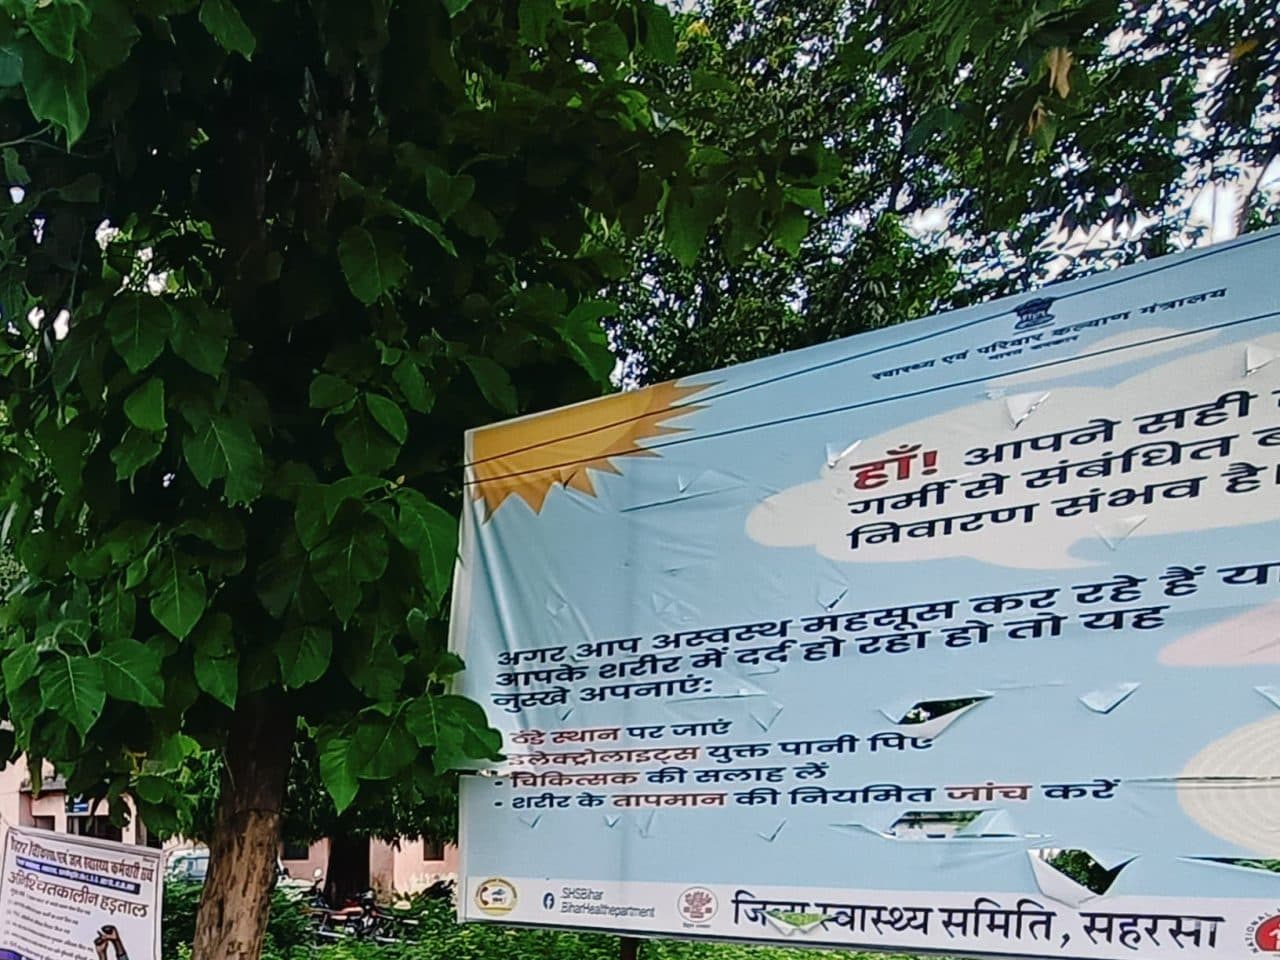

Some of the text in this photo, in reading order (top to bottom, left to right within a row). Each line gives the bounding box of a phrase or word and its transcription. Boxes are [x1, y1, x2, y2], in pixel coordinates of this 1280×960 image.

[942, 350, 969, 364] एवं
[977, 333, 1044, 354] परिवार
[1051, 311, 1132, 337] कल्याण
[1139, 288, 1227, 314] मंत्रालय
[964, 418, 1122, 466] आपने
[1132, 390, 1259, 434] सही
[848, 479, 958, 515] गर्मी
[960, 473, 1010, 499] से
[1021, 434, 1239, 489] संबंधित
[846, 503, 1040, 550] निवारण
[1051, 476, 1208, 517] संभव
[497, 561, 1280, 666] अगर आप अस्वस्थ महसूस कर रहे हैं य
[495, 605, 1171, 688] आपके शरीर में दर्द हो रहा हो तो यह
[491, 673, 713, 713] नुस्खे अपनाएं:
[550, 728, 621, 744] स्थान
[626, 726, 665, 741] पर
[672, 718, 733, 737] जाएं
[706, 742, 772, 763] युक्त
[777, 734, 860, 755] पानी
[509, 762, 830, 788] चिकित्सक की सलाह लें
[512, 779, 1121, 809] शरीर के तापमान की नियमित जांच करें
[100, 894, 149, 918] हड़ताल
[814, 902, 933, 935] स्वास्थ्य
[1079, 912, 1225, 949] सहरसा
